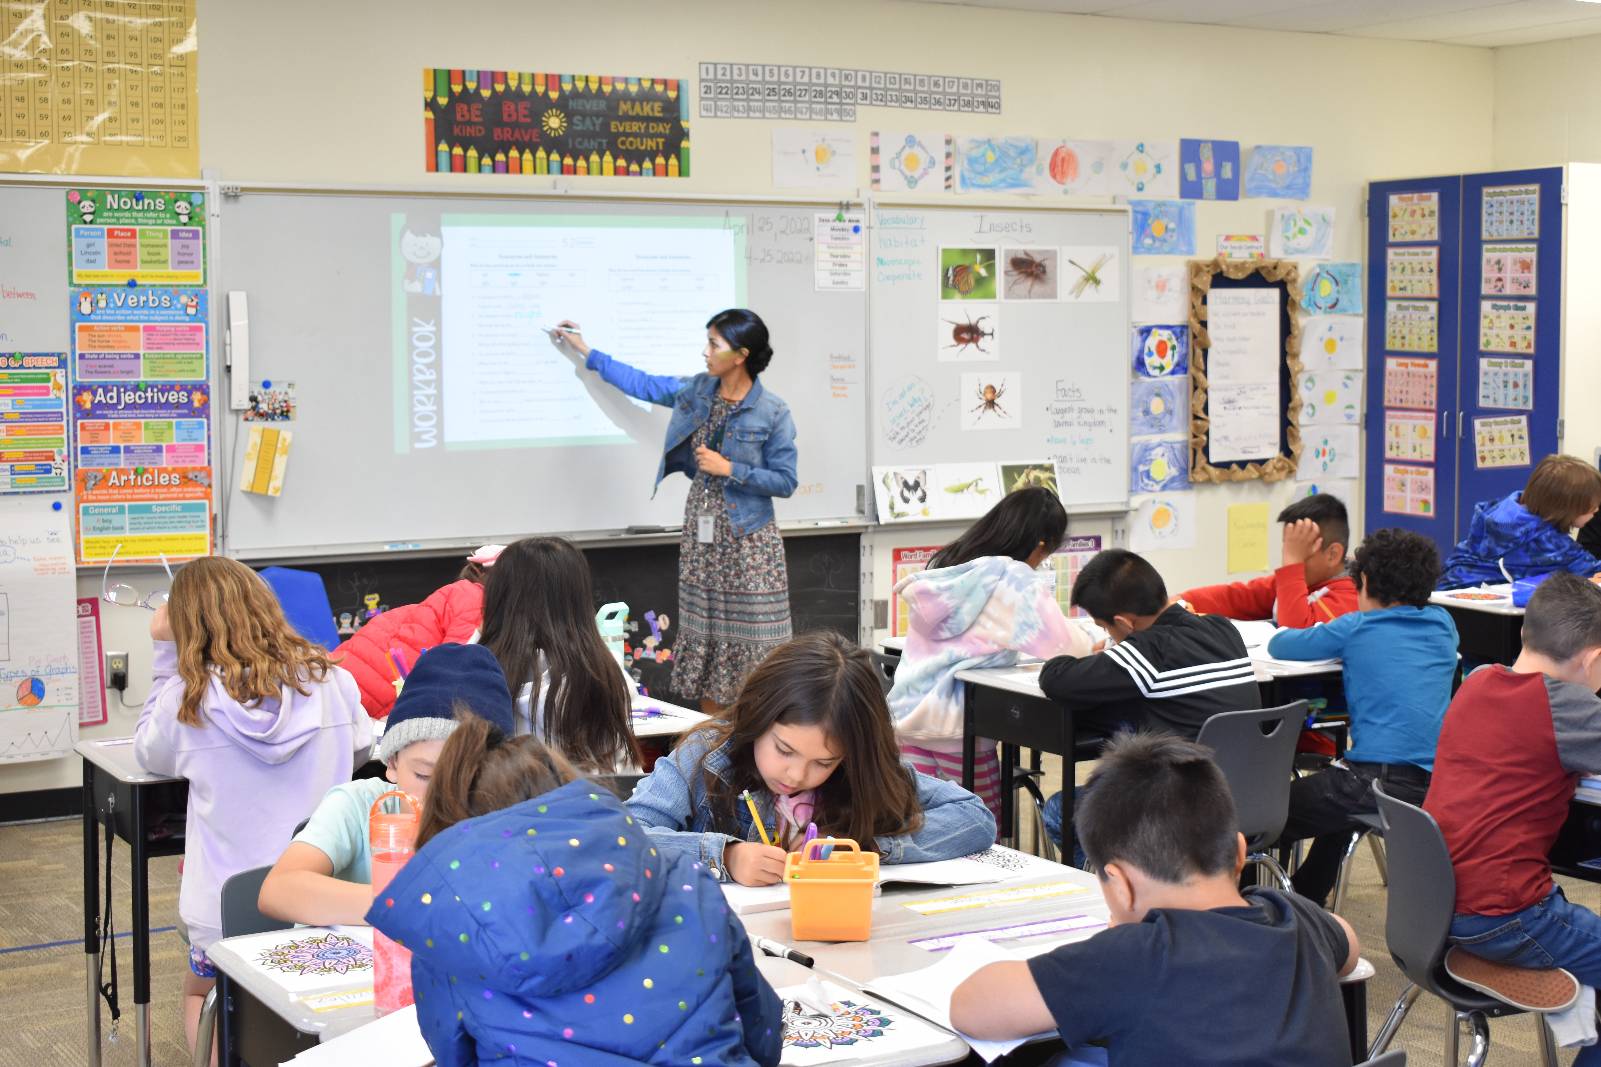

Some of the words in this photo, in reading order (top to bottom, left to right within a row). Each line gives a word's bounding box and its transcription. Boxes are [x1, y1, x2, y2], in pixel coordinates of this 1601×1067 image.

[721, 67, 726, 77] 2
[737, 68, 742, 77] 3
[752, 68, 758, 77] 4
[769, 69, 774, 77] 5
[784, 70, 790, 79] 6
[800, 71, 805, 80] 7
[816, 71, 821, 80] 8
[831, 72, 835, 80] 9
[844, 72, 852, 82] 10
[568, 99, 607, 112] NEVER
[704, 85, 712, 94] 21
[718, 86, 729, 95] 22
[734, 86, 746, 95] 23
[750, 87, 760, 96] 24
[766, 88, 777, 96] 25
[782, 88, 792, 97] 26
[798, 88, 808, 97] 27
[813, 89, 823, 98] 28
[828, 90, 838, 98] 29
[843, 90, 853, 99] 30
[859, 92, 867, 100] 31
[873, 92, 884, 102] 32
[888, 93, 898, 102] 33
[902, 94, 913, 104] 34
[918, 95, 928, 104] 35
[932, 96, 942, 106] 36
[947, 98, 956, 107] 37
[962, 99, 970, 108] 38
[975, 100, 985, 109] 39
[988, 101, 999, 110] 40
[455, 103, 482, 122] BE
[503, 101, 531, 123] BE
[618, 101, 663, 116] MAKE
[453, 125, 485, 137] KIND
[572, 115, 603, 131] SAY
[610, 120, 645, 133] EVERY
[649, 123, 671, 134] DAY
[493, 127, 541, 142] BRAVE
[568, 138, 572, 149] I
[575, 138, 608, 150] CAN'T
[617, 137, 664, 150] COUNT
[106, 194, 165, 210] Nouns
[779, 215, 811, 235] 2022
[877, 216, 925, 226] Vocabulary
[973, 215, 1032, 233] Insects
[114, 290, 171, 307] Verbs
[24, 357, 58, 366] SPEECH
[412, 317, 437, 448] WORKBOOK
[1056, 379, 1082, 398] Facts
[94, 386, 188, 409] Adjectives
[108, 470, 180, 486] Articles
[901, 550, 918, 560] Word
